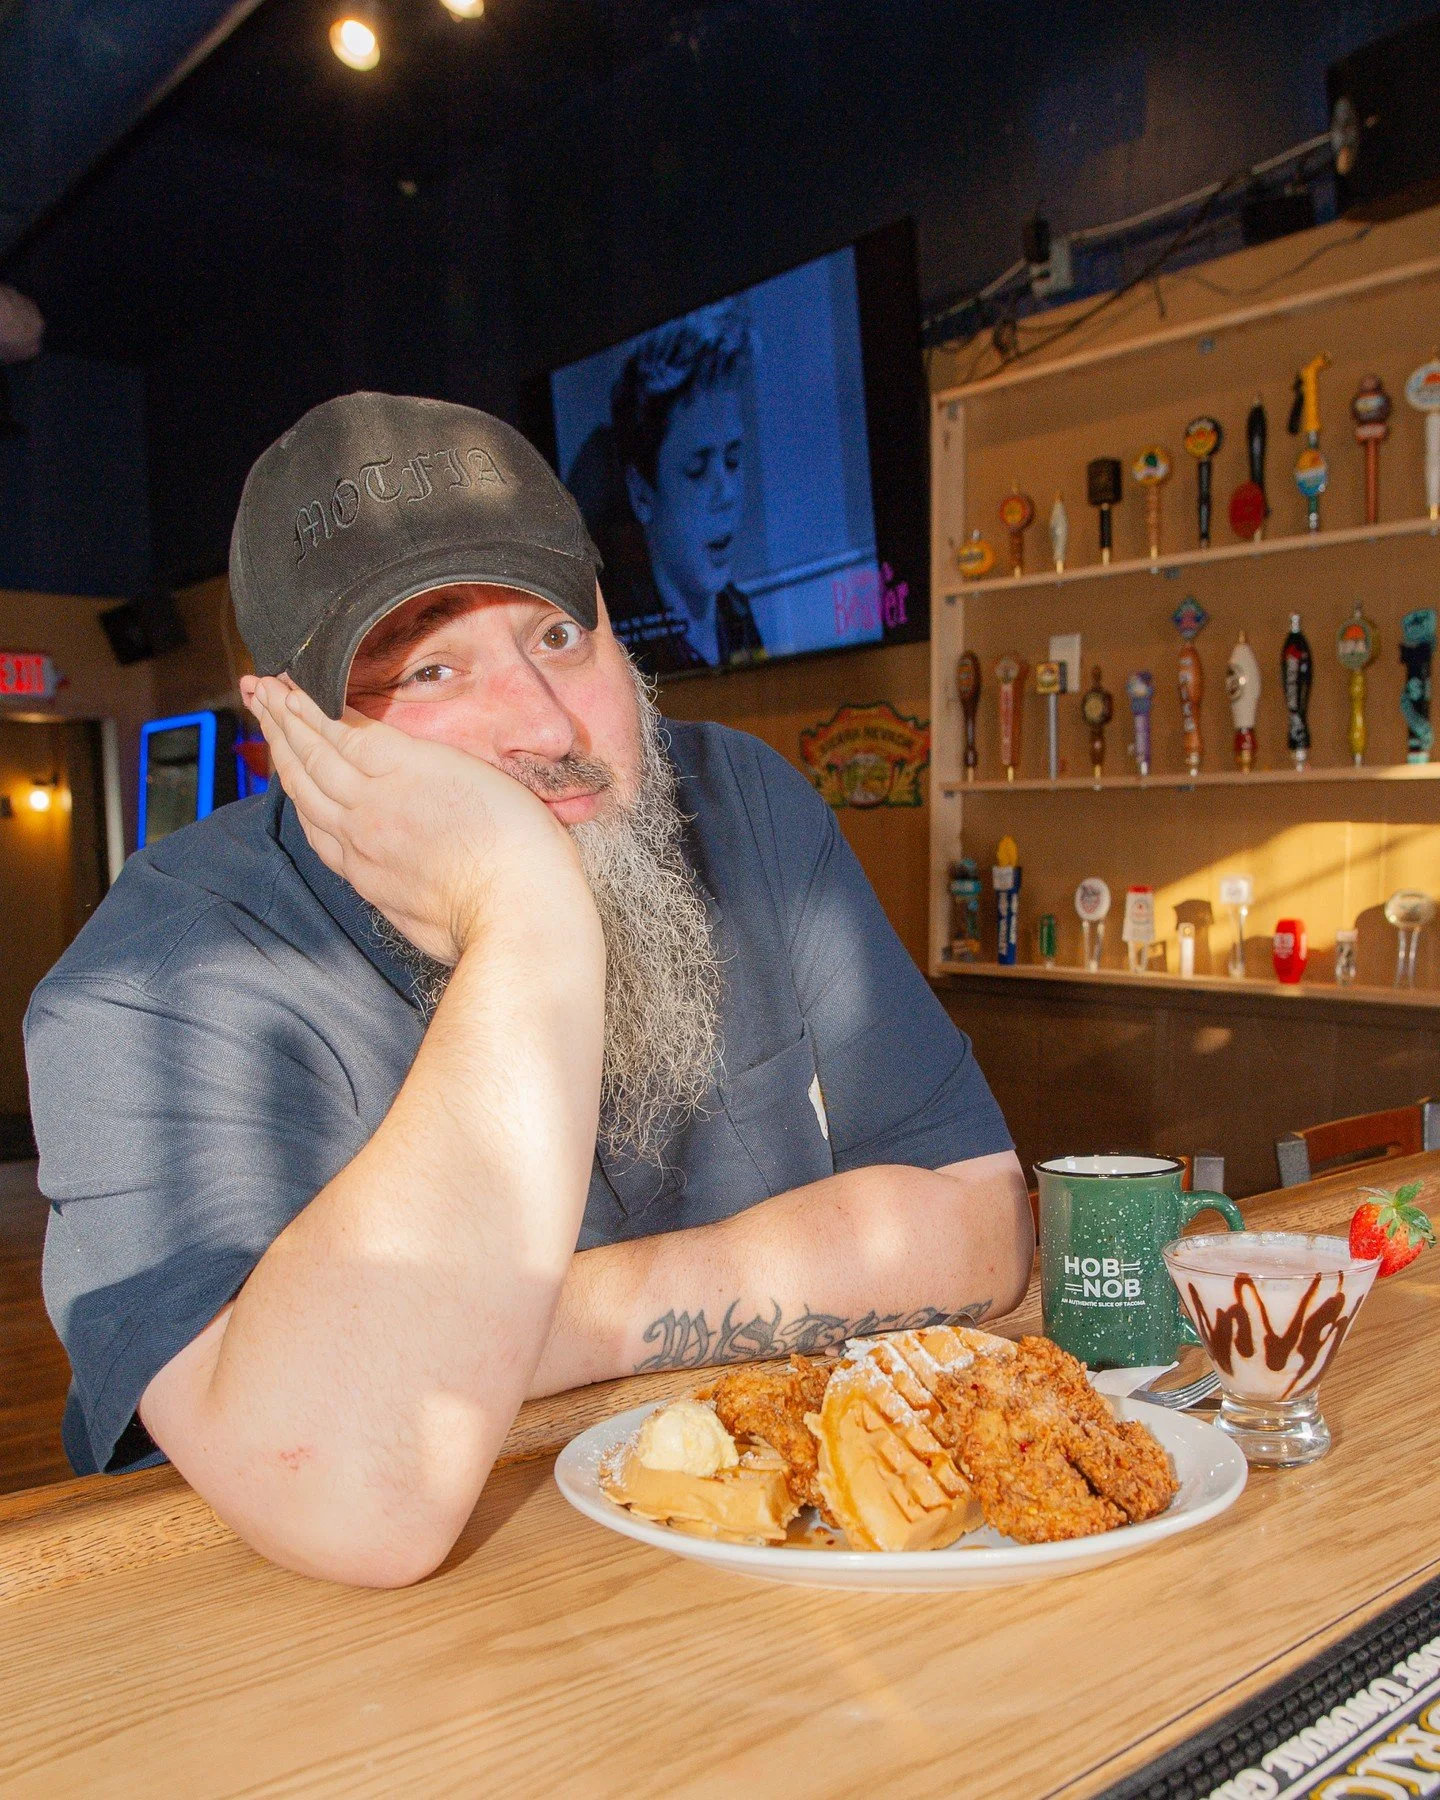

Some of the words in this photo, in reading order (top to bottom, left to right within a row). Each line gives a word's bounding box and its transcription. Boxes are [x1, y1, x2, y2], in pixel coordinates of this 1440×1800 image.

[293, 447, 507, 569] MOTFIA
[1064, 1255, 1120, 1278] HOB
[1083, 1279, 1141, 1298] NOB
[1068, 1299, 1098, 1308] AUTHENTIC
[1123, 1299, 1146, 1307] TACOMA
[1261, 1677, 1413, 1780] UNUSUAL
